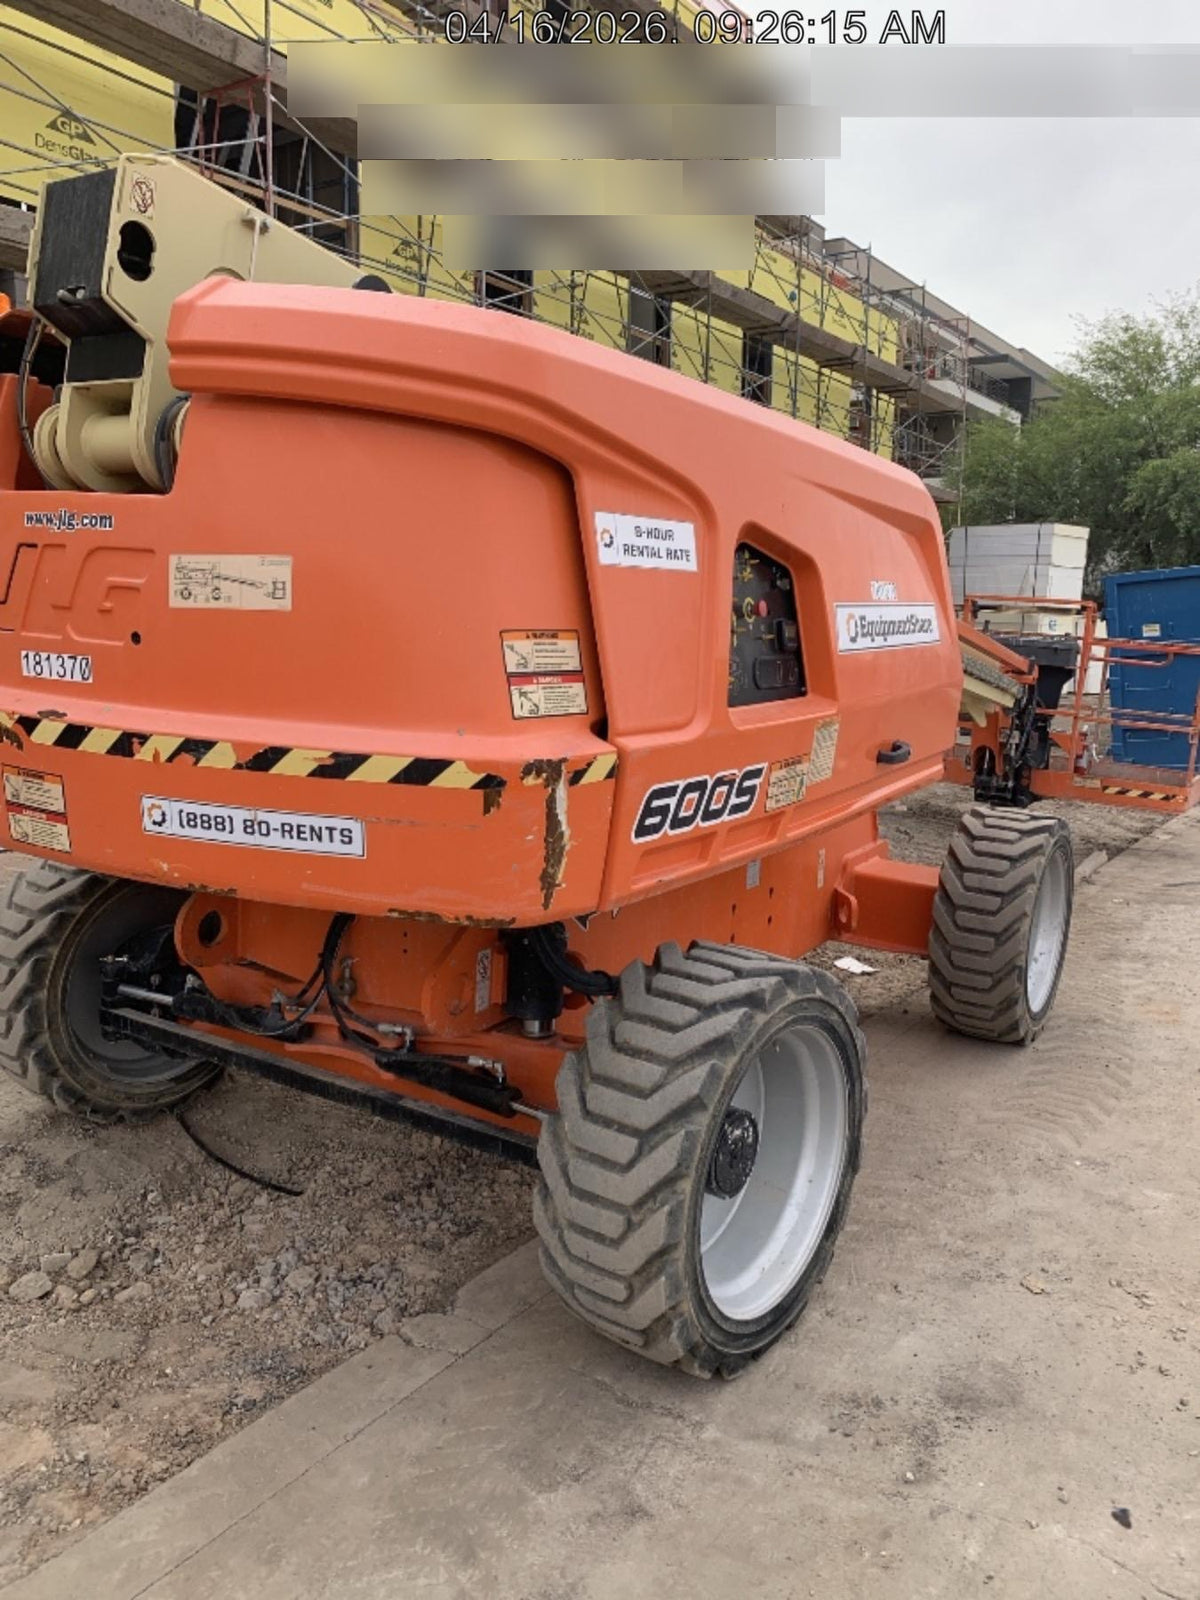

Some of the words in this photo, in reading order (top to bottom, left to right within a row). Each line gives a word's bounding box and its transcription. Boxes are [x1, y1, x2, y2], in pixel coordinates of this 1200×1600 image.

[56, 116, 84, 135] GP
[26, 510, 113, 530] www.jlg.com
[622, 543, 663, 560] RENTAL
[666, 548, 691, 563] RATE
[22, 652, 92, 682] 181370
[632, 763, 767, 843] 600S
[178, 809, 234, 834] (888)
[242, 818, 354, 846] 80-RENTS
